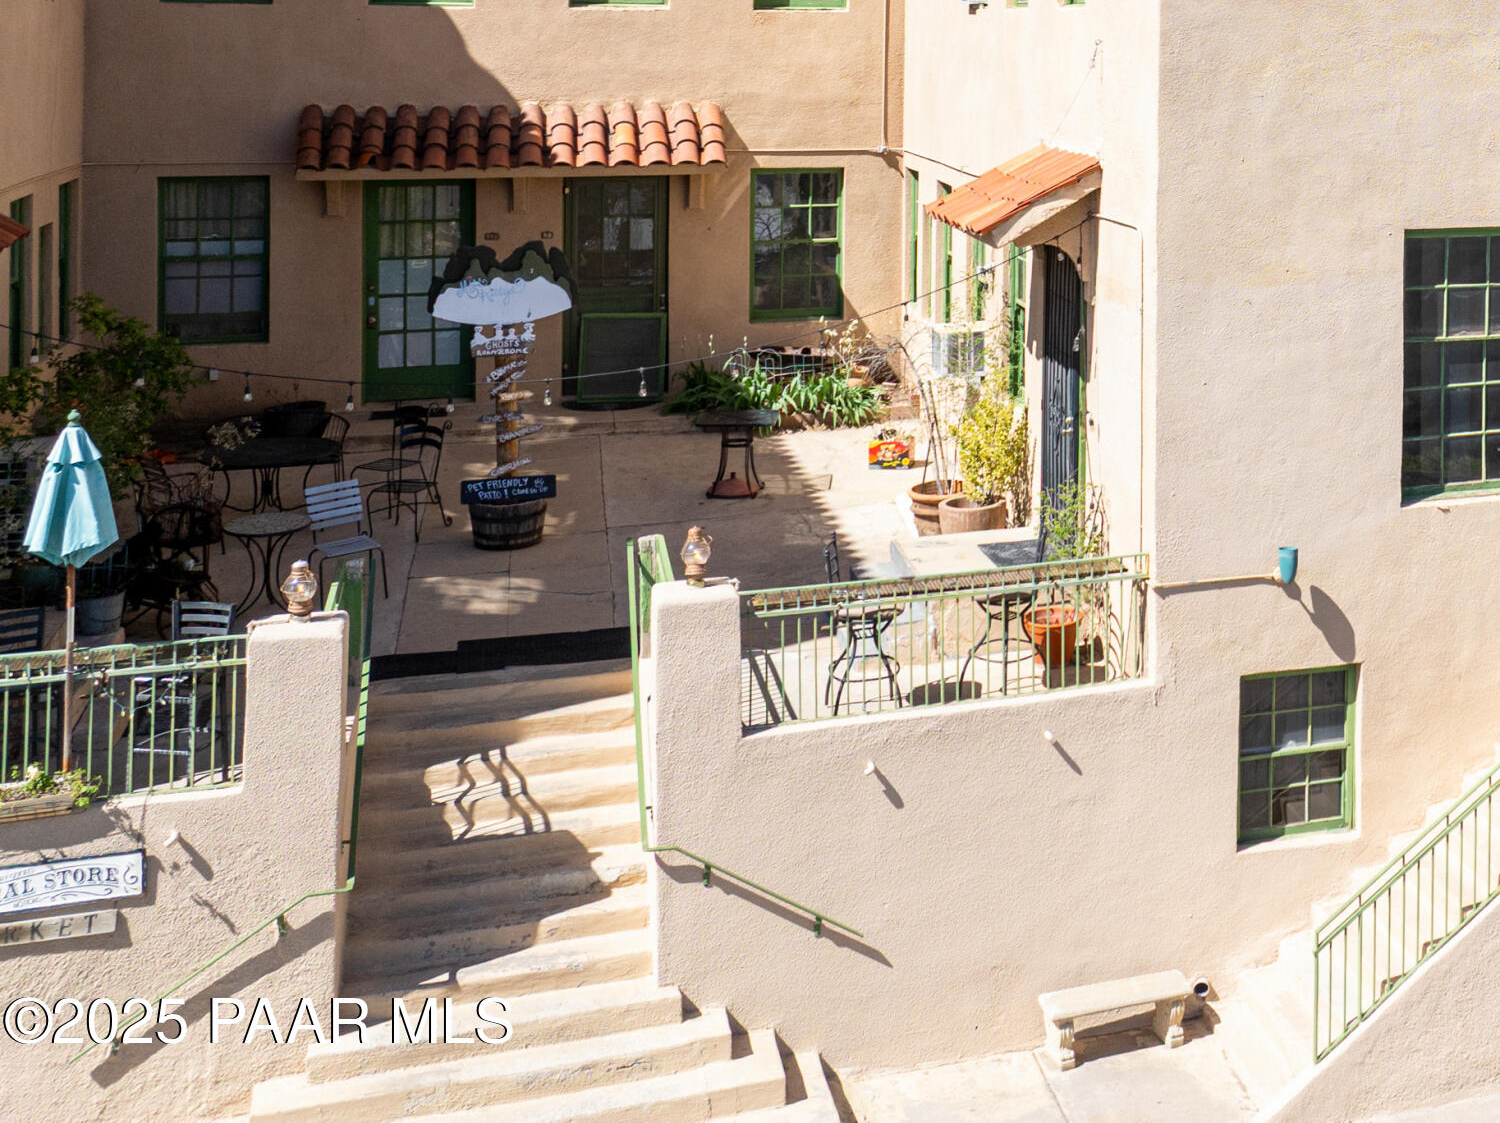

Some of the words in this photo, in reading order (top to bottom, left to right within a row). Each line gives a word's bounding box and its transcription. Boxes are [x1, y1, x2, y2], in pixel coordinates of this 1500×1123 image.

[485, 339, 521, 351] GHOSTS
[467, 482, 484, 493] PET
[486, 477, 529, 490] FRIENDLY
[2, 878, 35, 899] AL
[44, 867, 120, 890] STORE
[3, 914, 98, 944] RKET
